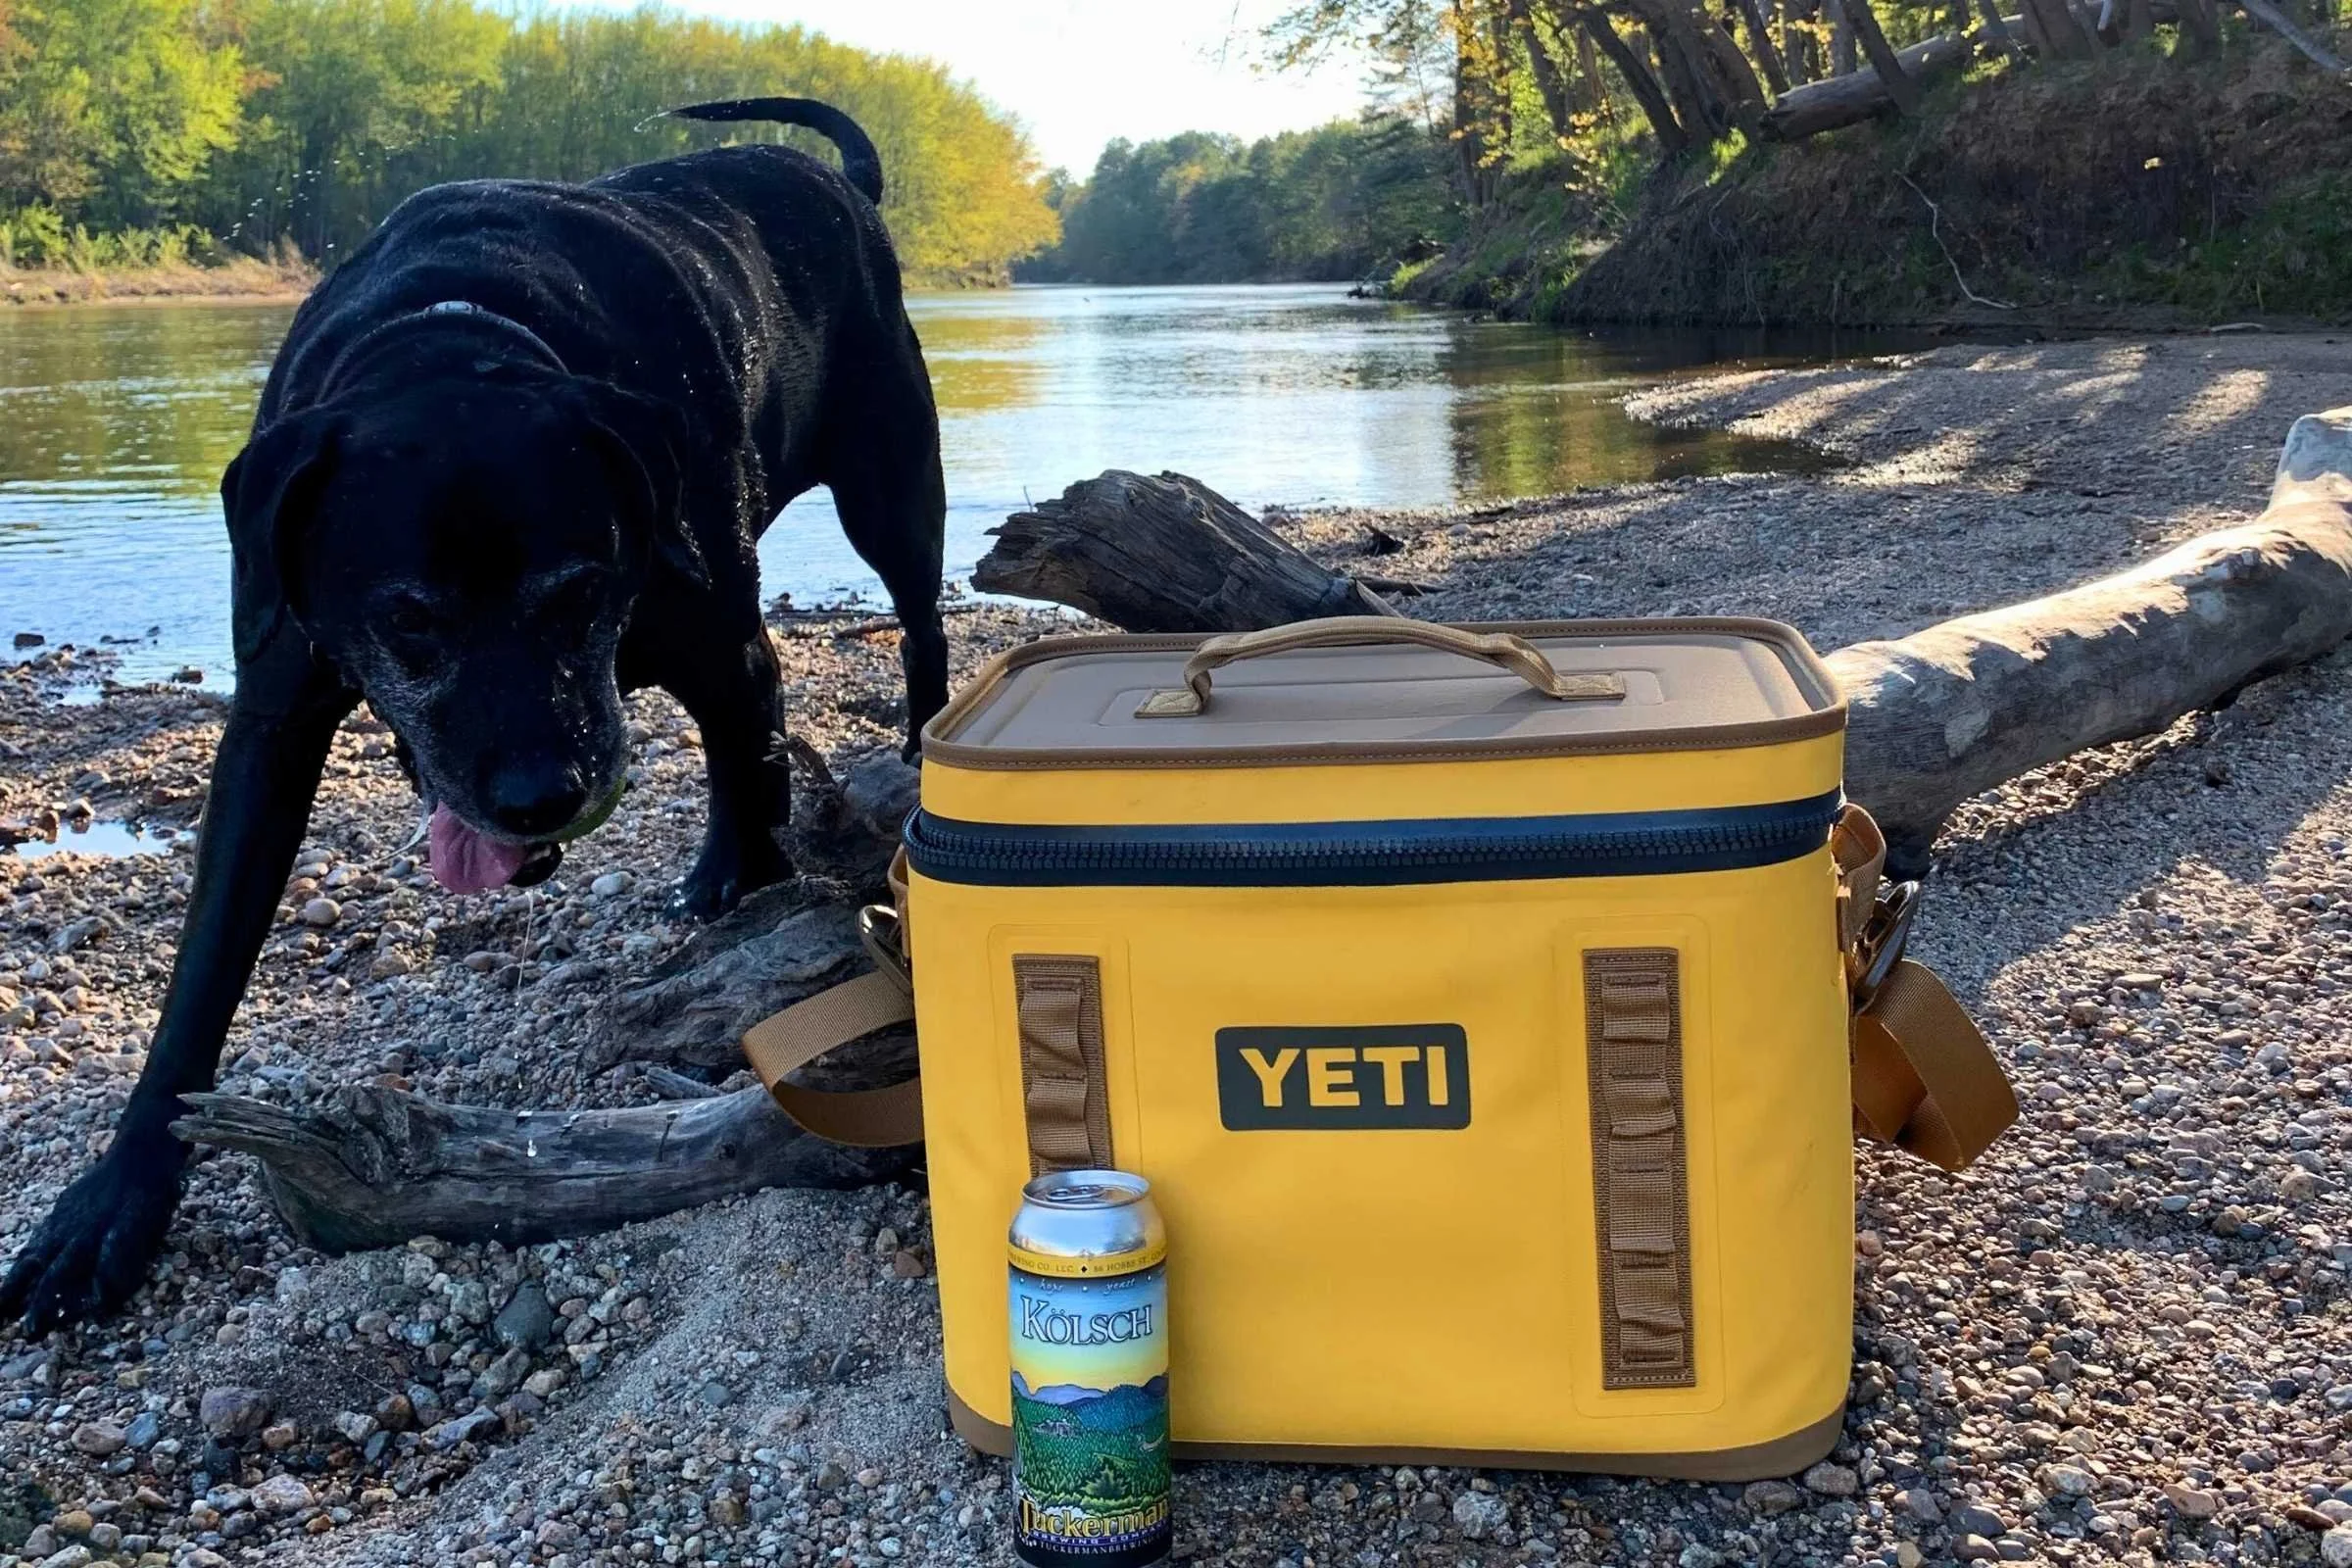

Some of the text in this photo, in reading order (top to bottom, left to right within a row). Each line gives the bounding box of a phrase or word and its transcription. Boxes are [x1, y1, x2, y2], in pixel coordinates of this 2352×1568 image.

[1239, 1046, 1448, 1106] YETI
[1019, 1496, 1168, 1538] Tuckerman
[1032, 1531, 1099, 1544] BREWING
